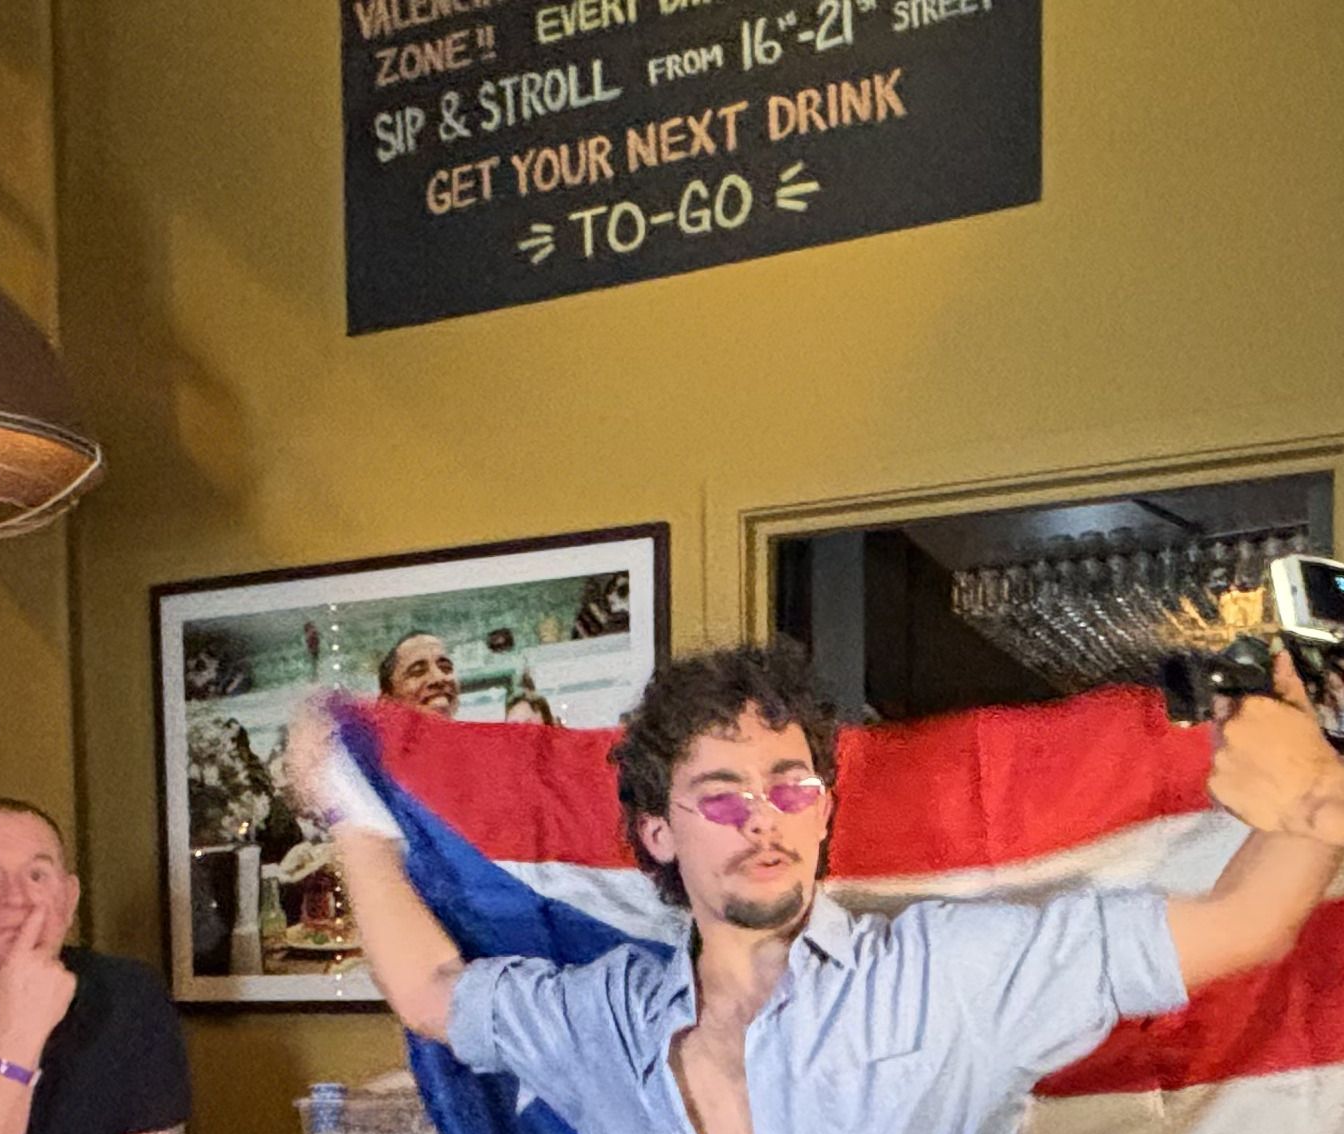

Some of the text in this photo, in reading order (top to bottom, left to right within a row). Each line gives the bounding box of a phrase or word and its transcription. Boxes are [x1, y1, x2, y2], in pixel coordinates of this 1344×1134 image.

[374, 106, 426, 163] SIP
[439, 91, 471, 143] &
[477, 59, 624, 132] STROLL
[648, 44, 724, 87] FROM
[425, 67, 908, 215] GET YOUR NEXT DRINK
[568, 174, 754, 259] TO-GO
